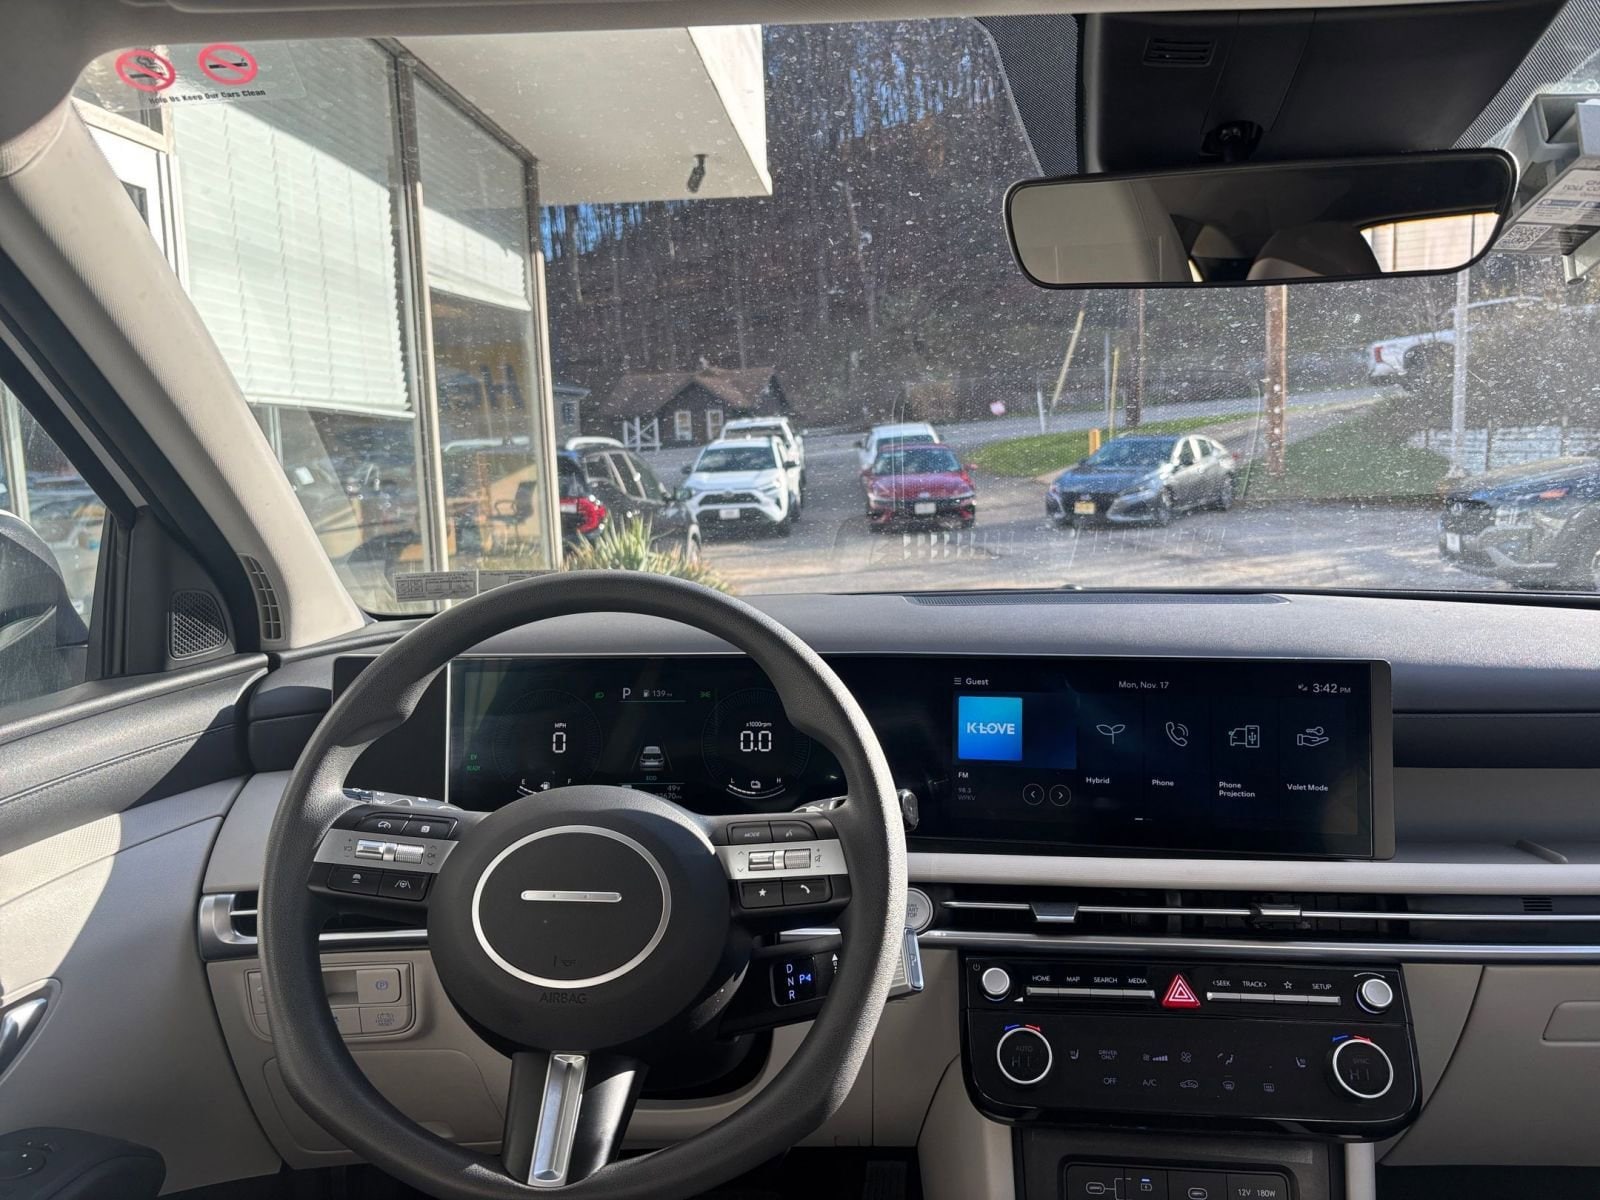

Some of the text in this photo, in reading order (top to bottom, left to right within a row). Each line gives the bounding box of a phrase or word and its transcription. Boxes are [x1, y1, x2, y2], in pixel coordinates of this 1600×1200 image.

[182, 94, 203, 102] Keep
[241, 89, 266, 97] Clean
[965, 677, 989, 686] Guest
[1118, 680, 1170, 689] Mon, Nov. 17
[1312, 683, 1338, 694] 3:42
[622, 687, 632, 700] P
[653, 689, 667, 698] 139
[552, 732, 567, 753] 0
[740, 730, 772, 752] 0.0
[958, 771, 969, 779] FM
[1085, 776, 1110, 785] Hybrid
[1151, 779, 1175, 787] Phone
[1218, 781, 1242, 789] Phone
[1286, 783, 1329, 792] Valet Mode
[1218, 789, 1256, 798] Projection
[786, 963, 794, 974] D
[787, 976, 795, 987] N
[1093, 976, 1118, 984] SEARCH
[539, 991, 587, 1004] AIRBAG
[788, 989, 796, 1001] R
[1103, 1077, 1117, 1085] OFF
[1142, 1078, 1158, 1087] A/C
[1237, 1188, 1277, 1198] 12V 180W
